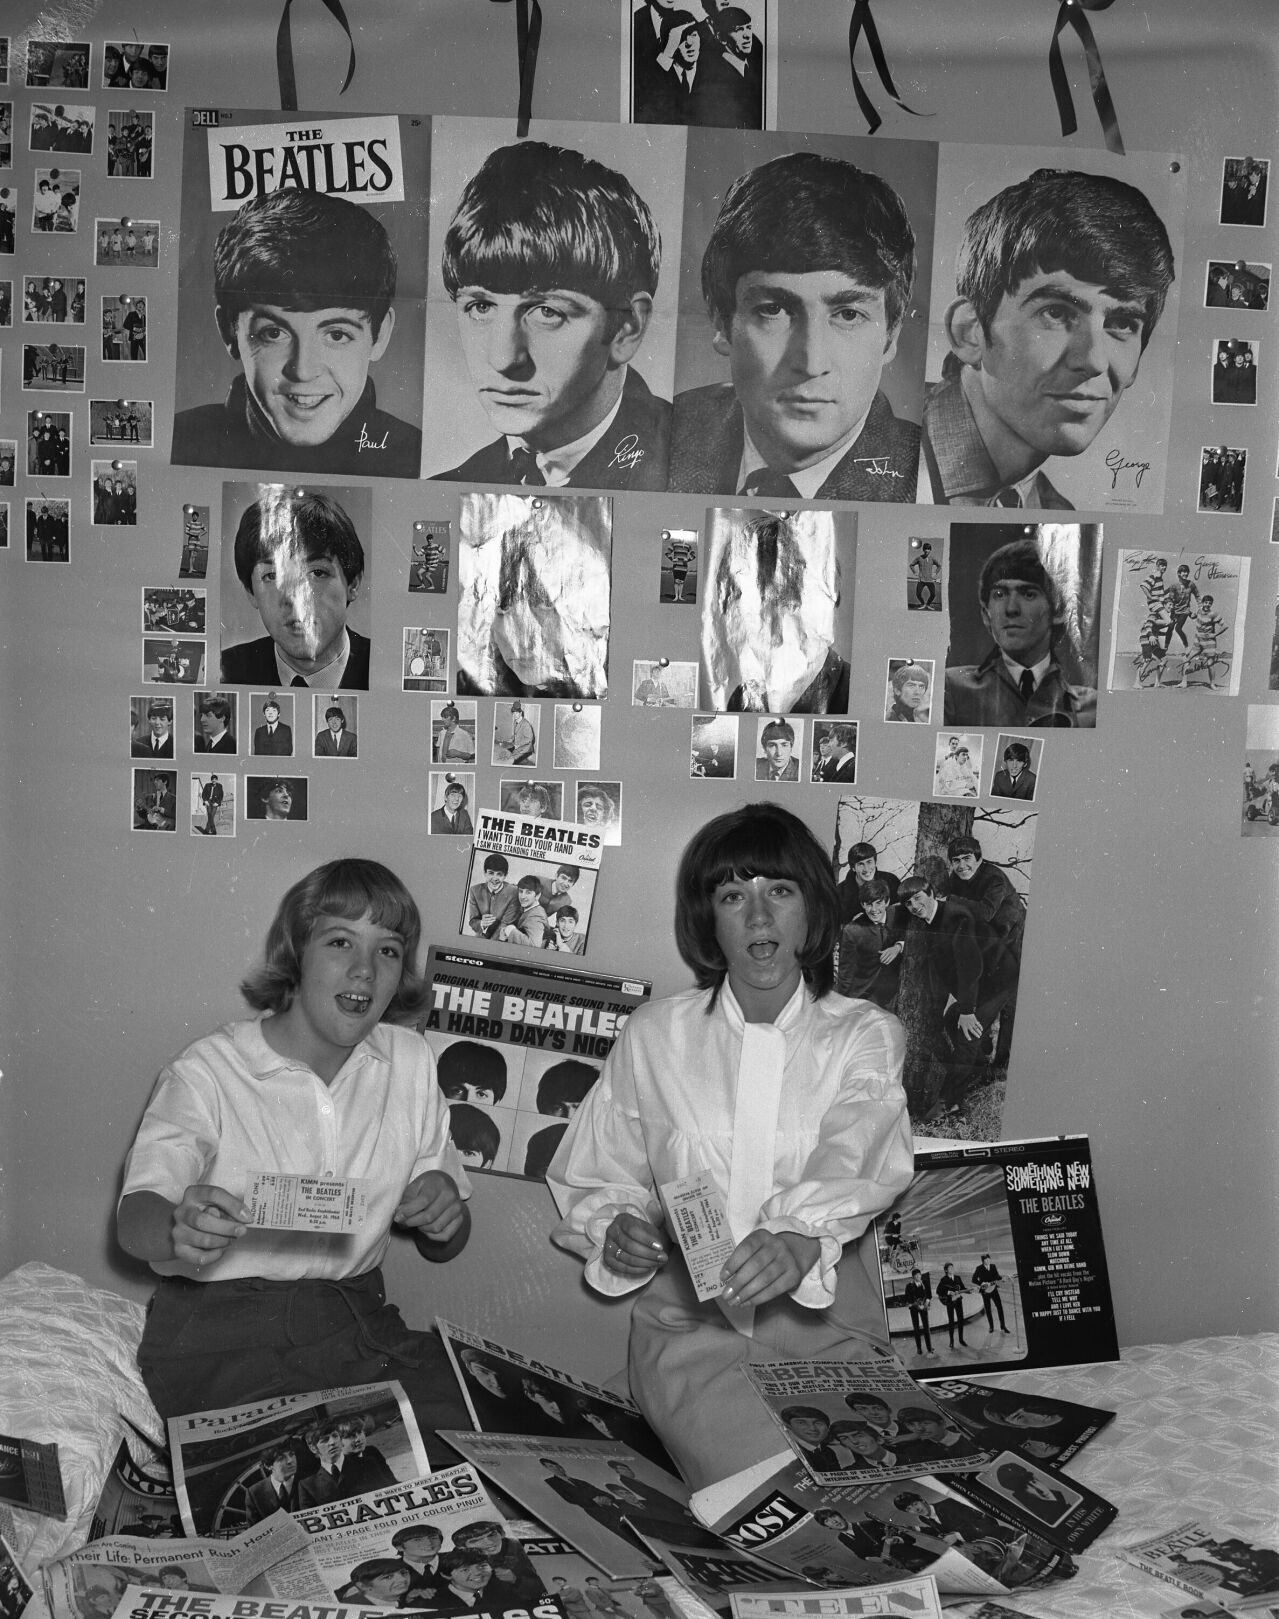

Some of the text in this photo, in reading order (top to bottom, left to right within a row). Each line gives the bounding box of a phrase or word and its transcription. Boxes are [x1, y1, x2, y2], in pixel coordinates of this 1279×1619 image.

[193, 111, 218, 126] DELL
[286, 129, 323, 142] THE
[218, 139, 393, 200] BEATLES
[355, 422, 389, 453] Paul
[608, 433, 645, 469] Ringo
[853, 456, 904, 479] John
[1105, 449, 1151, 489] George
[477, 829, 574, 855] I WANT TO HOLD YOUR HAND
[481, 815, 601, 849] THE BEATLES
[479, 841, 492, 849] SAW
[492, 843, 503, 851] HER
[503, 844, 529, 857] STANDING
[530, 848, 546, 859] THERE
[444, 954, 484, 967] stereo
[431, 983, 493, 1017] THE
[432, 972, 637, 1015] ORIGINAL MOTION PICTURE SOUND TRAC
[426, 1009, 440, 1030] A
[447, 1012, 503, 1039] HARD
[509, 1022, 567, 1050] DAY'S
[994, 1145, 1025, 1153] STEREO
[1006, 1161, 1089, 1181] SOMETHING NEW
[316, 1187, 342, 1197] BEATLES
[1007, 1174, 1090, 1193] SOMETHING NEW
[1019, 1193, 1085, 1214] THE BEATLES
[680, 1207, 699, 1246] THE BEATLES
[874, 1357, 895, 1365] STORY
[771, 1365, 901, 1381] BEATLES
[414, 1478, 433, 1488] MEET
[794, 1476, 815, 1493] THE
[292, 1510, 320, 1519] BEST
[340, 1498, 363, 1508] THE
[296, 1473, 479, 1534] BEATLES
[967, 1490, 991, 1508] LENNON
[374, 1519, 398, 1531] FOLD
[401, 1512, 420, 1523] OUT
[423, 1505, 454, 1517] COLOR
[456, 1496, 484, 1511] PINUP
[725, 1496, 799, 1550] POST
[1065, 1507, 1088, 1529] IN HIS
[1067, 1526, 1085, 1544] OWN
[1143, 1528, 1211, 1560] BEATLE
[69, 1551, 101, 1562] Their
[133, 1550, 203, 1565] Permanent
[208, 1548, 241, 1558] Rush
[1138, 1562, 1205, 1600] THE BEATLE BOOK
[140, 1592, 216, 1614] THE
